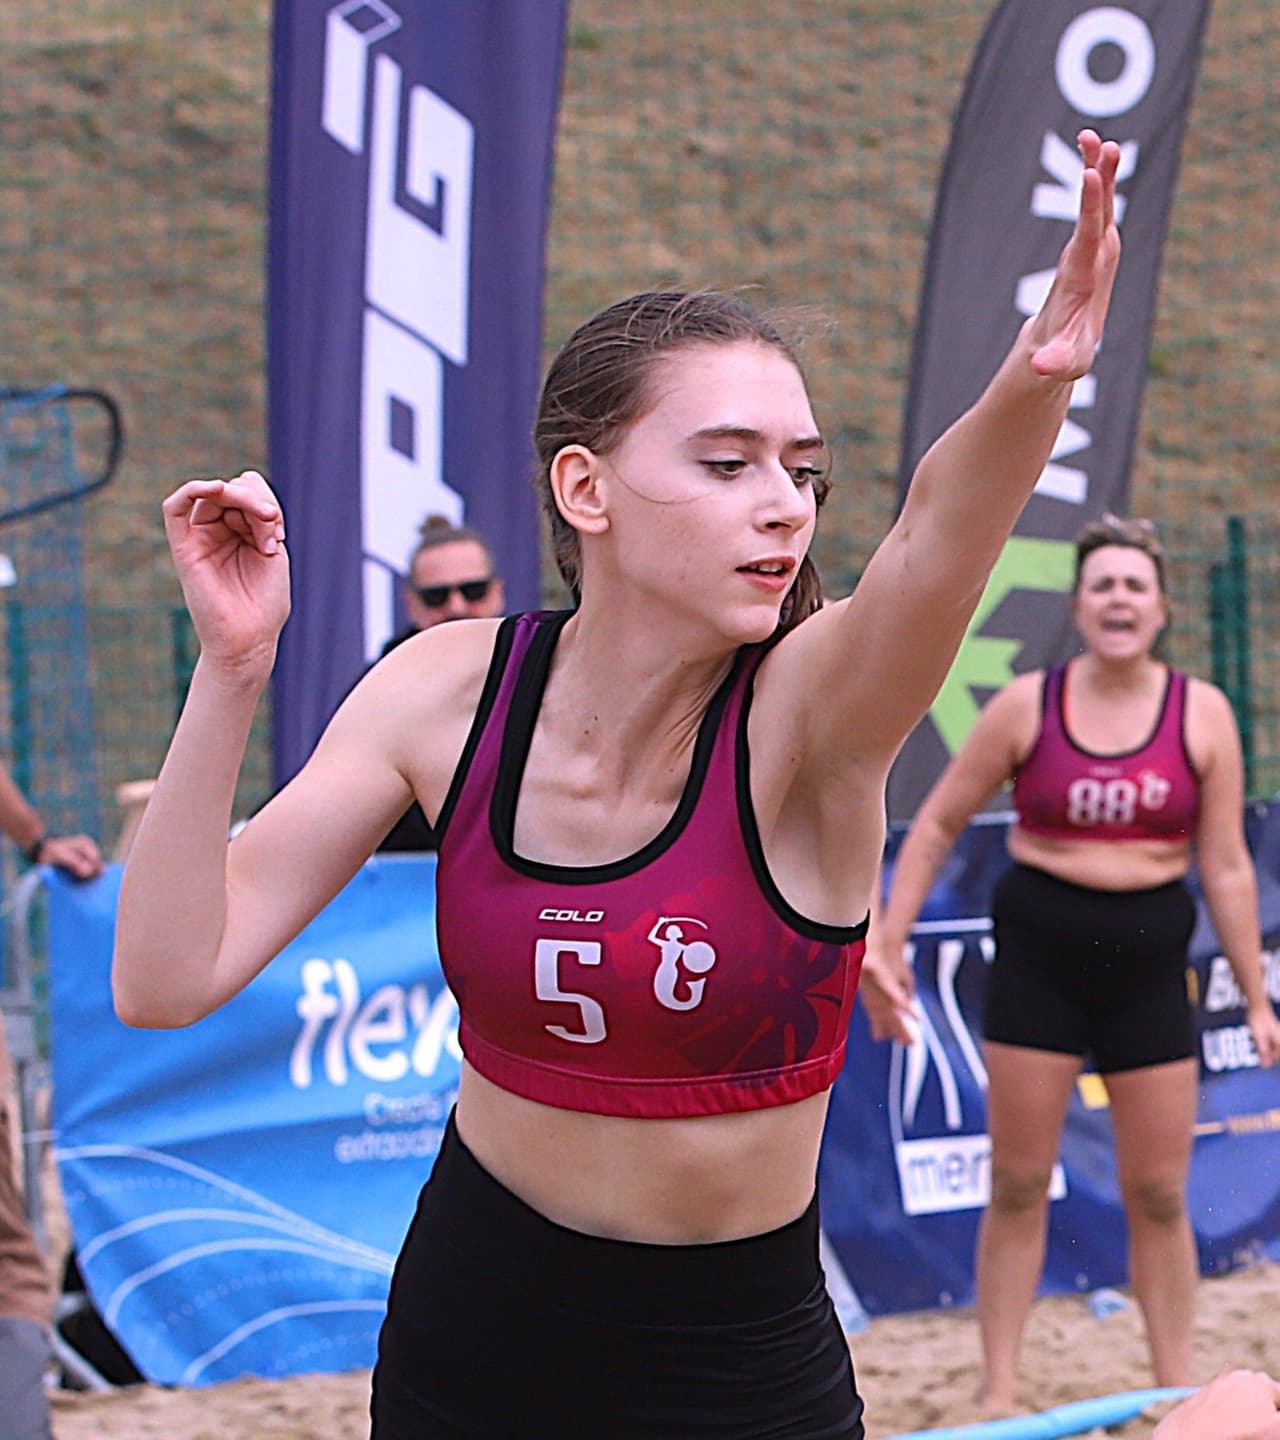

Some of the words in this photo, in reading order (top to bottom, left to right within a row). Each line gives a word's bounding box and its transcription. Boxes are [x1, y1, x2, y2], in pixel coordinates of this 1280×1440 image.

[1067, 777, 1139, 827] 88
[538, 908, 604, 923] COLO
[534, 938, 607, 1044] 5
